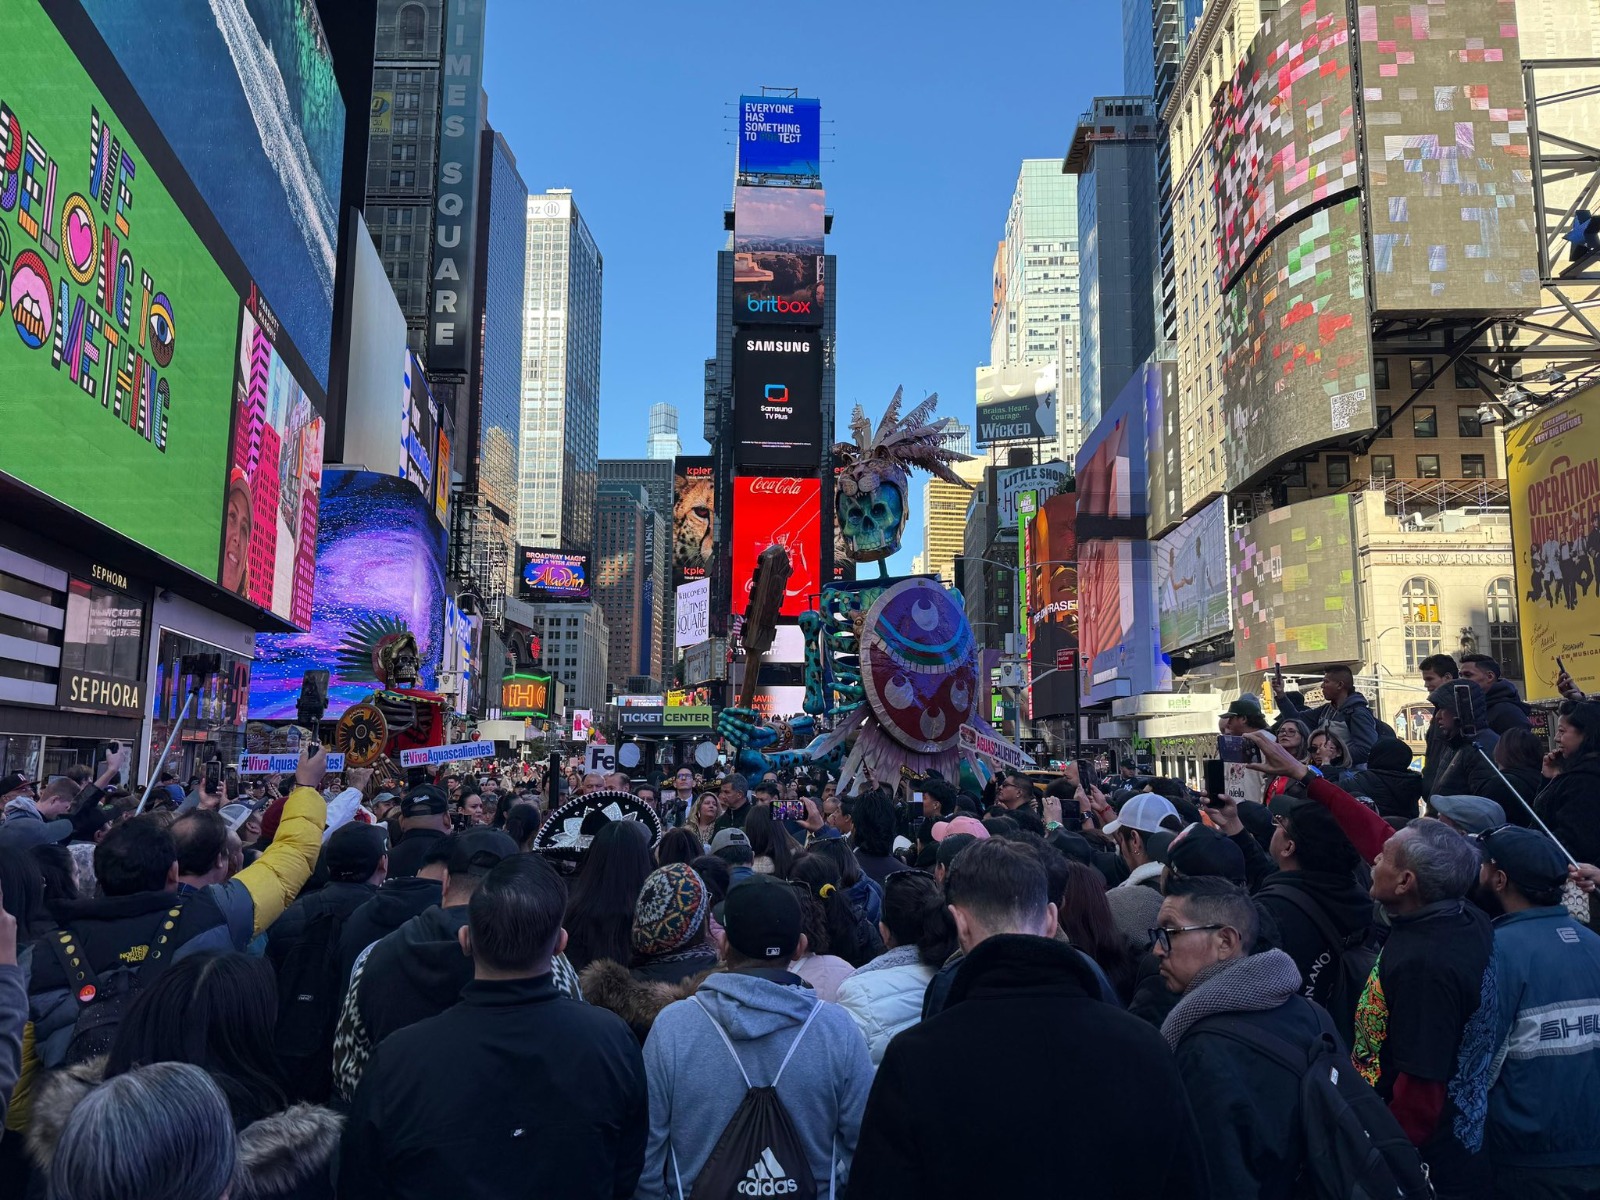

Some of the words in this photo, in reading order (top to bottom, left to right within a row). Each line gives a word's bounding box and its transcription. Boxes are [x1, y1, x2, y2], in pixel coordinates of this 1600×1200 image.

[745, 103, 794, 114] EVERYONE
[745, 113, 765, 122] HAS
[745, 122, 800, 134] SOMETHING
[745, 132, 757, 141] TO
[434, 161, 464, 346] SQUARE
[747, 294, 811, 314] britbox
[746, 340, 810, 353] SAMSUNG
[760, 405, 793, 414] Samsung
[1008, 404, 1030, 412] Heart.
[990, 413, 1021, 421] Courage.
[1534, 431, 1549, 445] VERY
[1549, 426, 1560, 438] BIG
[1560, 415, 1582, 433] FUTURE
[686, 467, 713, 476] kpler
[1003, 468, 1037, 490] LITTLE
[750, 476, 803, 495] Coca-Cola
[1528, 457, 1600, 517] OPERATION
[525, 551, 563, 560] BROADWAY
[564, 555, 586, 563] MAGIC
[1388, 553, 1410, 564] THE
[1415, 553, 1449, 564] SHOW
[1455, 553, 1492, 564] FOLKS
[92, 563, 128, 590] SEPHORA
[525, 566, 585, 588] Aladdin
[677, 588, 700, 600] WELCOME
[677, 611, 708, 635] SQUARE
[70, 675, 139, 709] SEPHORA
[621, 713, 663, 723] TICKET
[664, 713, 709, 723] CENTER
[402, 741, 494, 765] #VivaAguascalientes!
[976, 735, 1021, 768] AGUASCALIENTES
[737, 1178, 798, 1196] adidas
